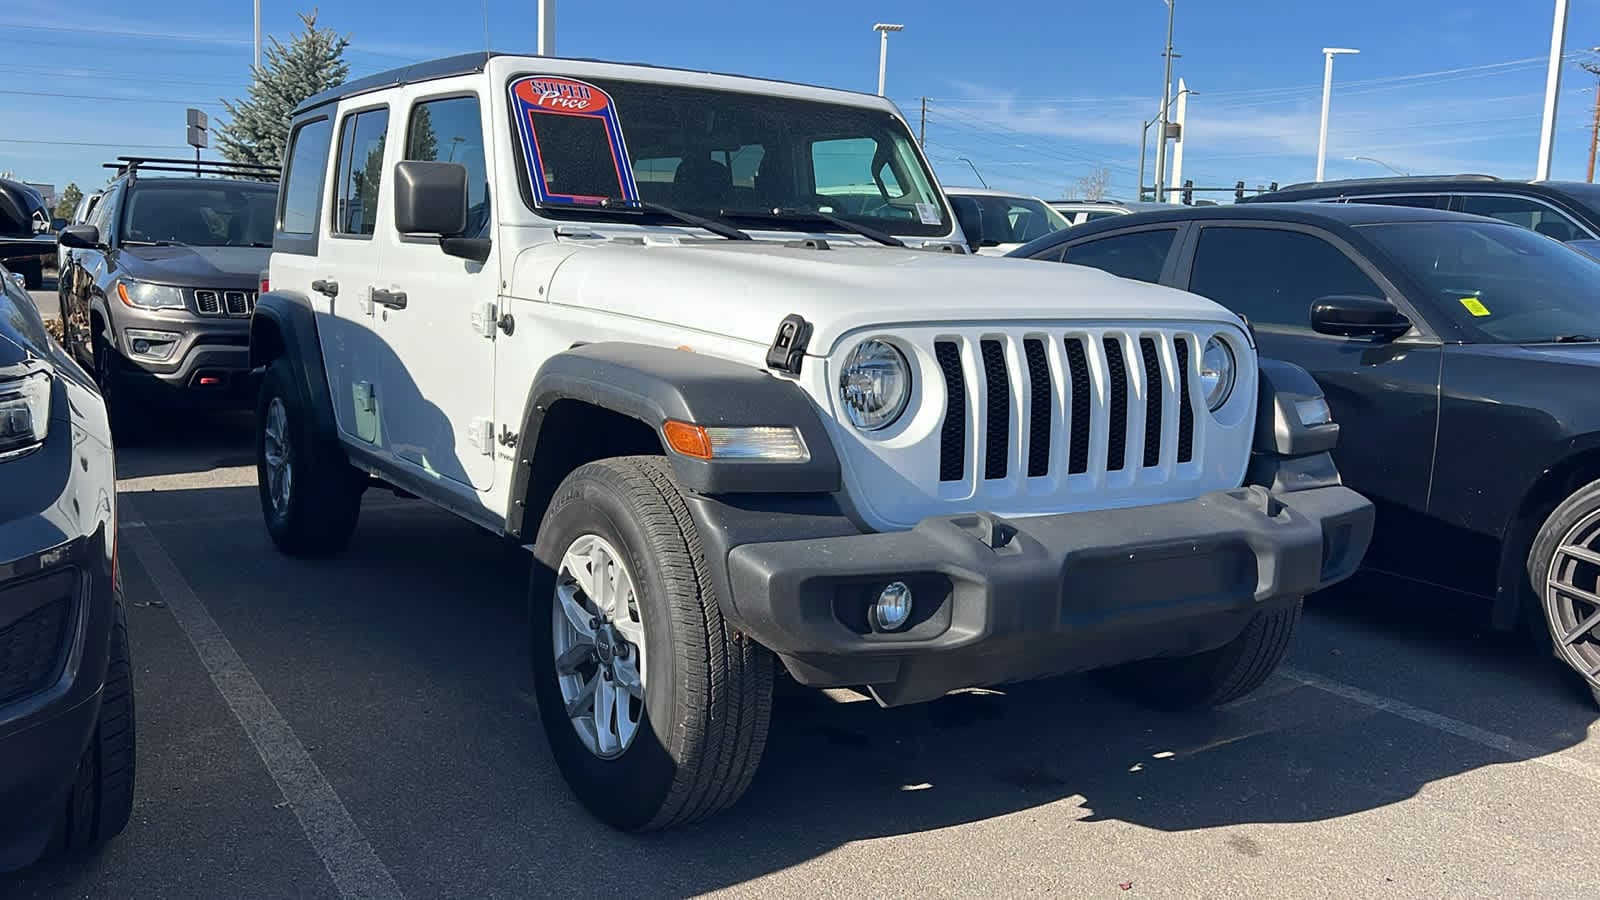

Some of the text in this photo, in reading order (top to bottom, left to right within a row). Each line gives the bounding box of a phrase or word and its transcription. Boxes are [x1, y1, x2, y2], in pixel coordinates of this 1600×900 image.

[530, 80, 592, 100] SUPER
[538, 91, 591, 109] Price
[498, 424, 519, 448] Jee
